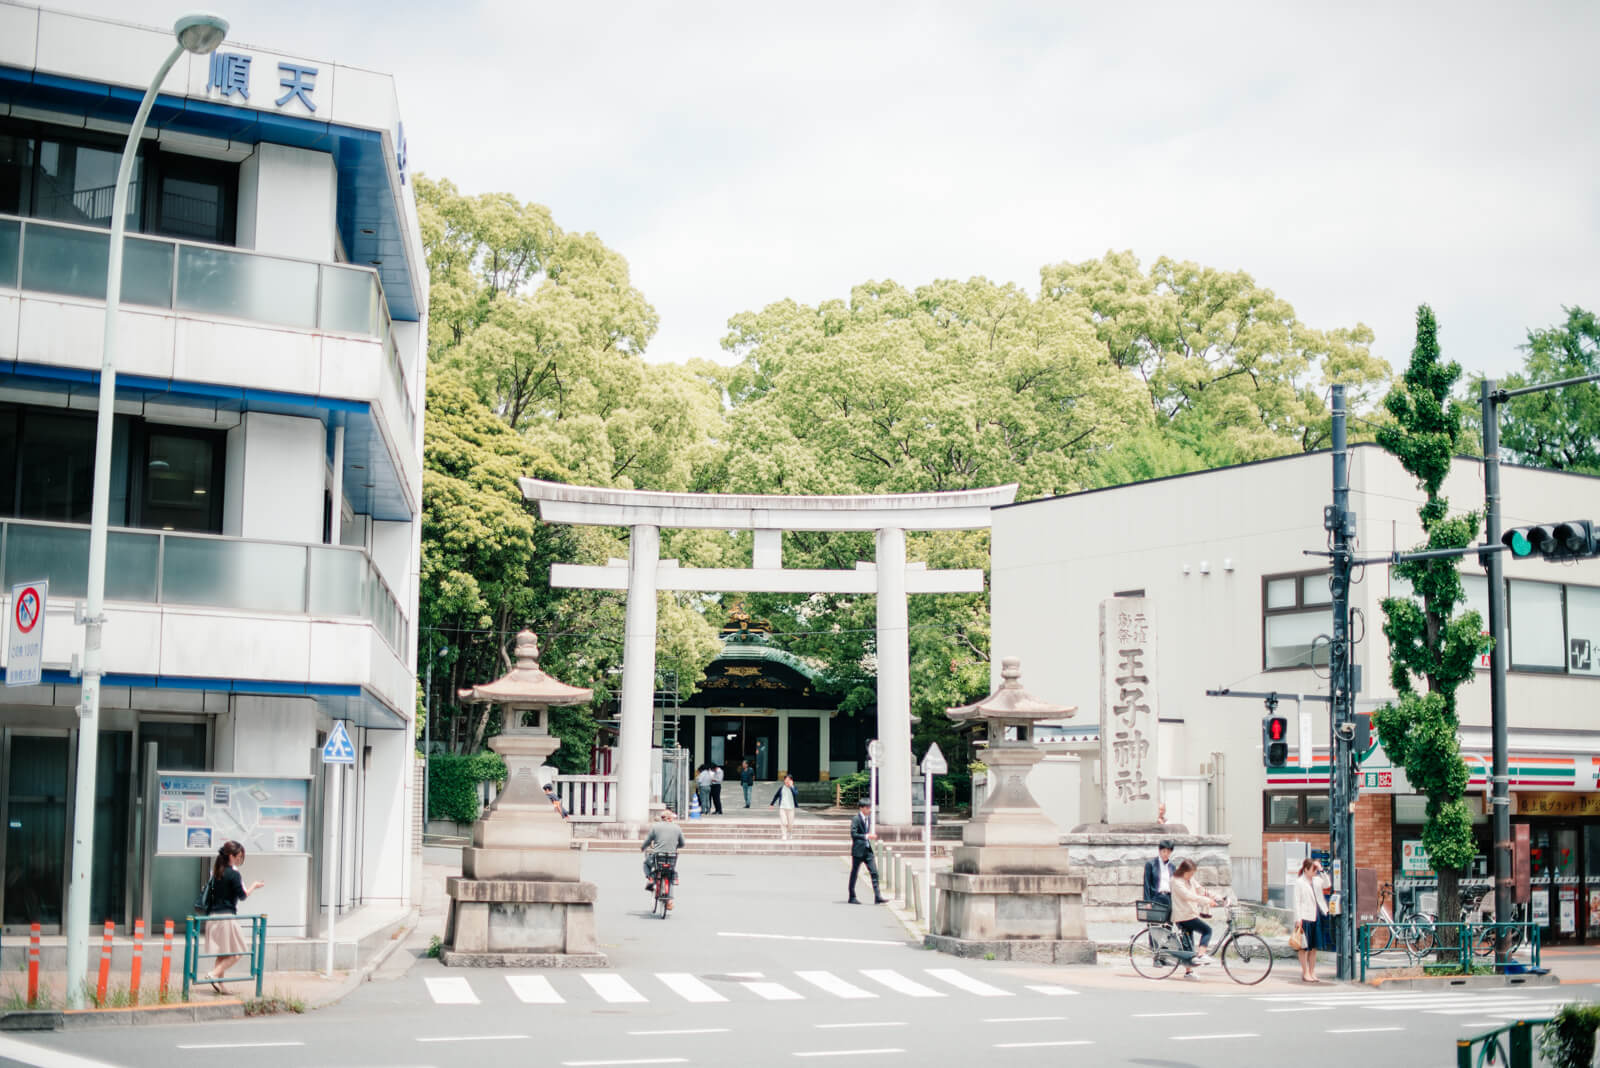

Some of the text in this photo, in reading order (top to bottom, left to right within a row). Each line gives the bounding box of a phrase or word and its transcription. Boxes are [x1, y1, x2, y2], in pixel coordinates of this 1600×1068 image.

[206, 50, 318, 112] 順天
[1113, 648, 1151, 803] 王子神社
